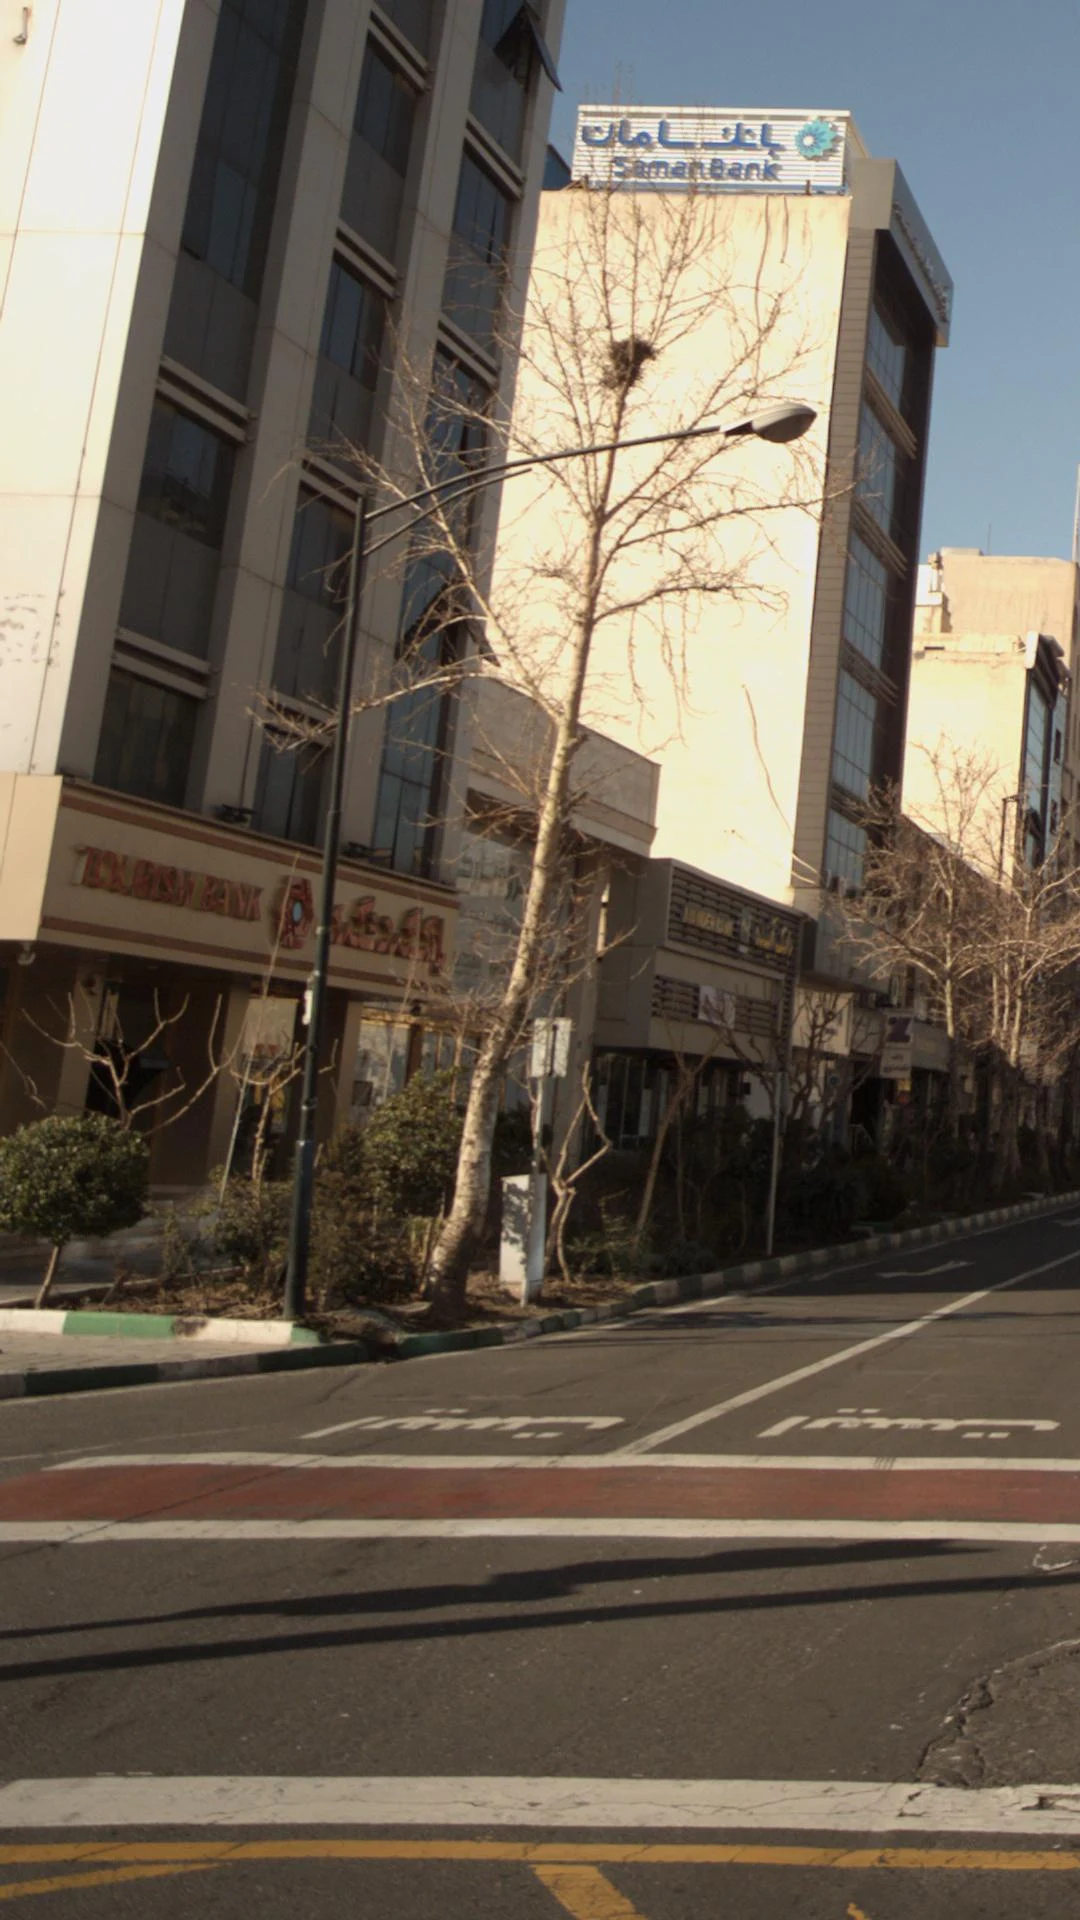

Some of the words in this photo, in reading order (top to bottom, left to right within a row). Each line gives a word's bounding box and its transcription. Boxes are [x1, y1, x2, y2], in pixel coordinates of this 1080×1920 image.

[581, 119, 698, 148] سامان
[701, 122, 786, 158] بانک
[612, 156, 704, 179] Saman
[710, 158, 780, 181] Bank
[756, 1407, 1060, 1439] ایست
